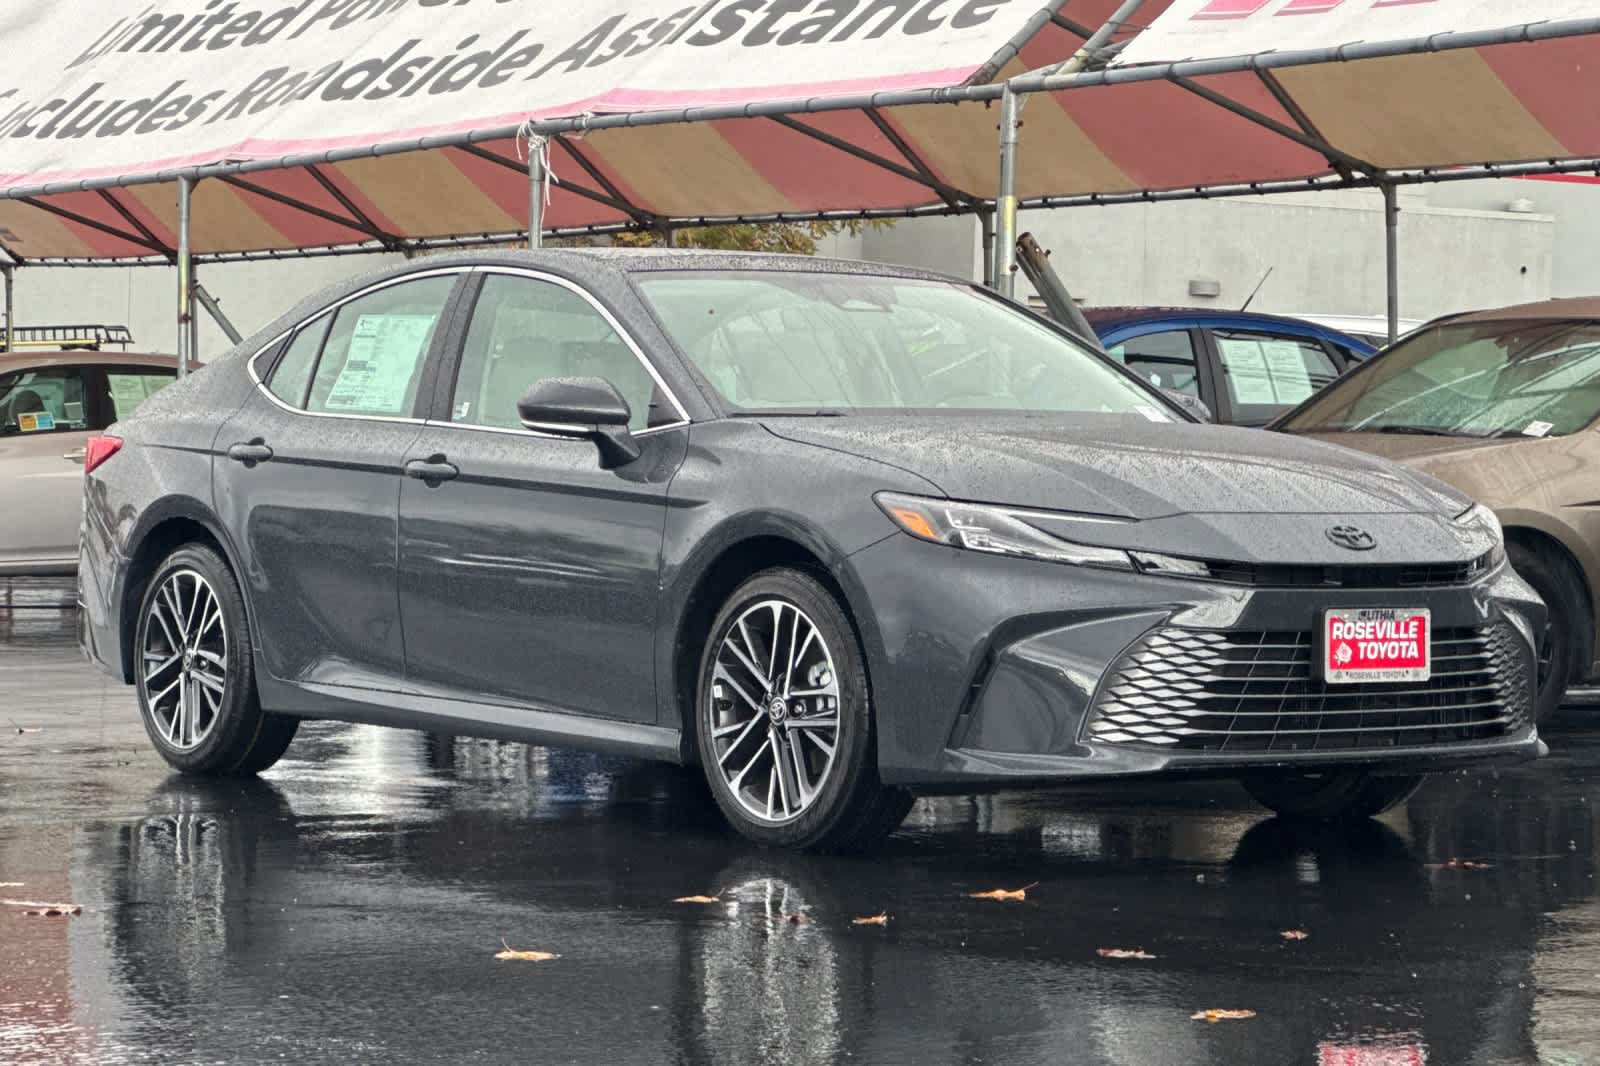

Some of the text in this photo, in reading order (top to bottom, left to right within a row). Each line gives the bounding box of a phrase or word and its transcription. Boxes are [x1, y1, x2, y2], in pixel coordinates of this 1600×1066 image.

[64, 0, 317, 71] Limited
[0, 79, 226, 139] ncludes
[201, 28, 544, 127] Roadside
[1332, 621, 1419, 640] ROSEVILLE
[1358, 641, 1419, 660] TOYOTA
